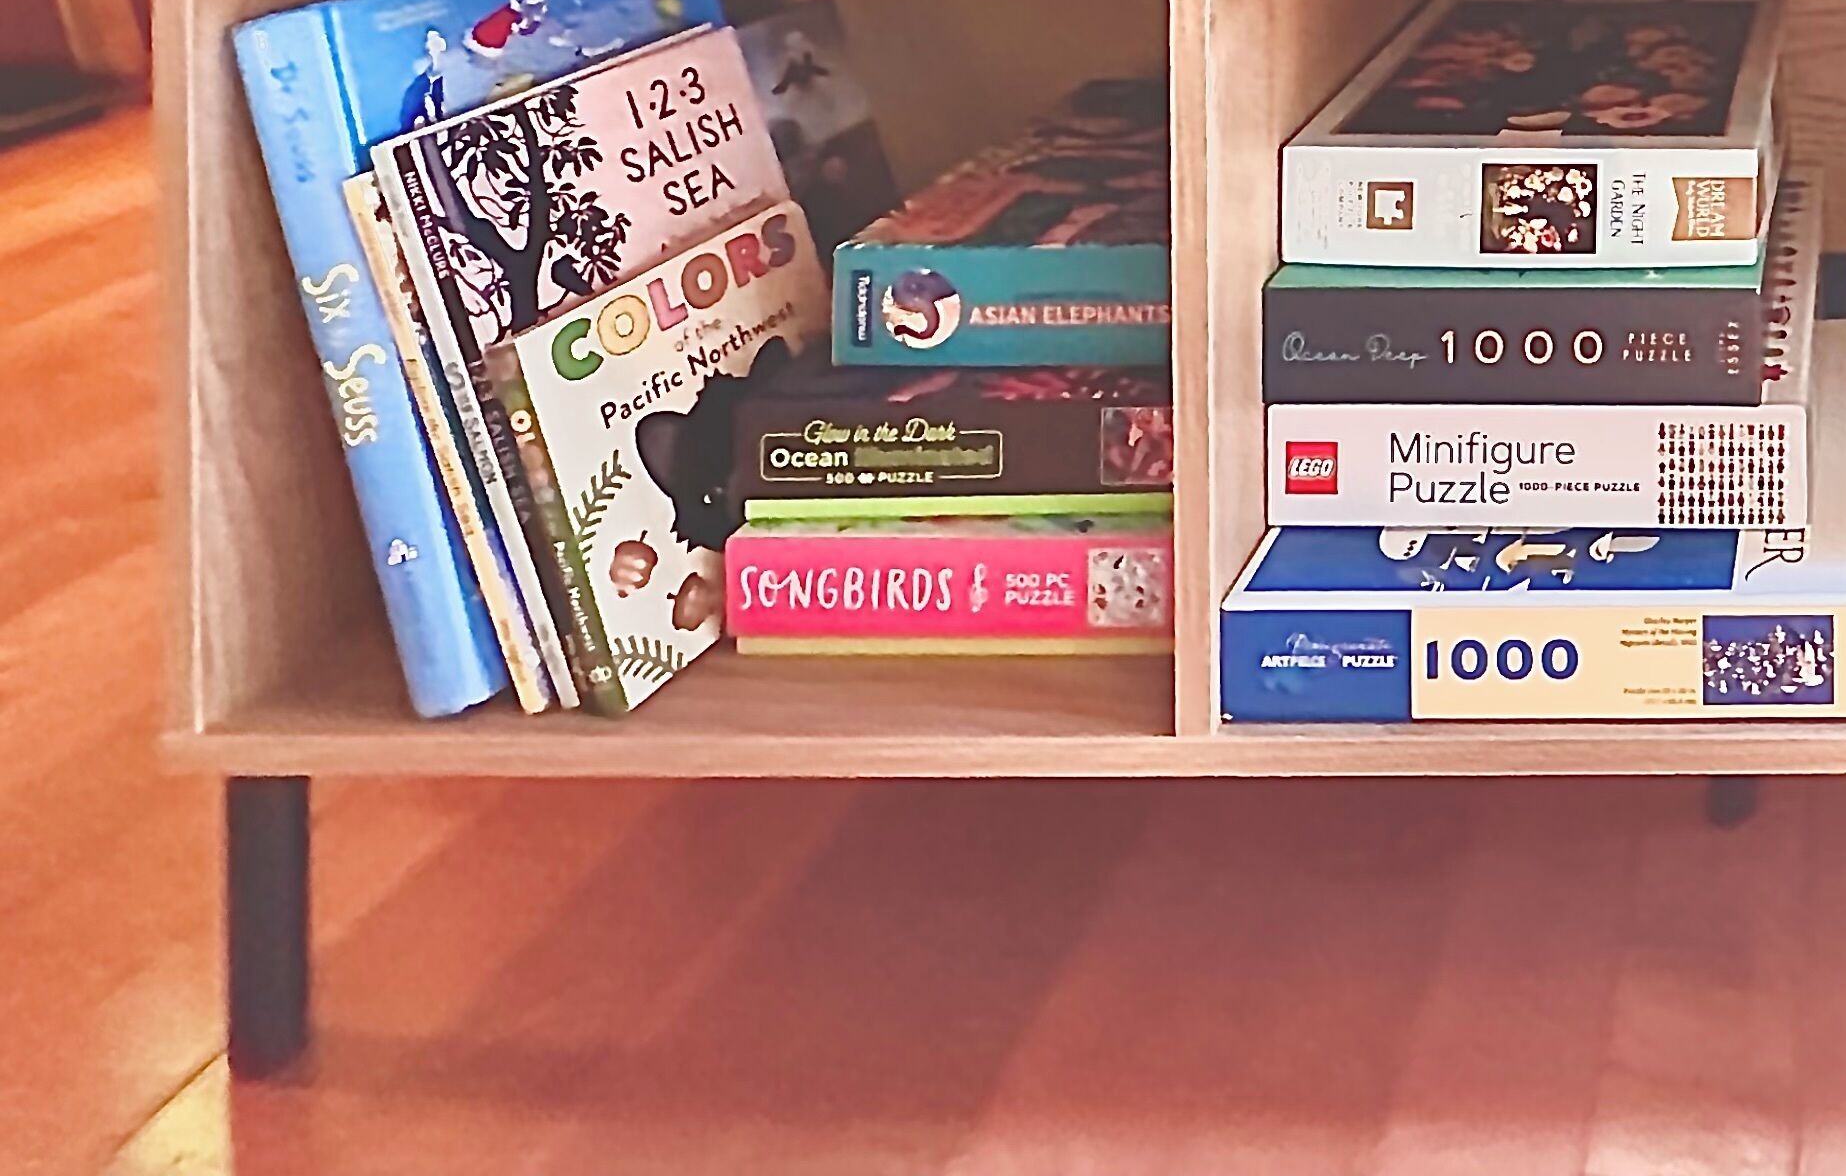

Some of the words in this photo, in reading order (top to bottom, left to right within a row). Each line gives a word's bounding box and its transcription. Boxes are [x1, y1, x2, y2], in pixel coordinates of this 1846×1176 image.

[620, 103, 743, 183] SALISH
[663, 164, 736, 216] SEA
[1631, 173, 1646, 196] THE
[404, 171, 427, 212] NIKKI
[420, 213, 450, 281] McCLURE
[1609, 179, 1626, 239] GARDEN
[1631, 203, 1646, 245] NIGHT
[1696, 179, 1710, 238] WORLD
[1708, 179, 1727, 237] DREAM
[301, 264, 359, 324] Six
[551, 213, 796, 382] COLORS
[969, 306, 1037, 325] ASIAN
[1042, 304, 1171, 324] ELEPHANTS
[674, 333, 693, 353] of
[695, 316, 722, 340] the
[1281, 331, 1361, 363] Ocean
[1627, 332, 1688, 345] PIECE
[600, 370, 684, 429] Pacific
[687, 302, 796, 376] Northwest
[1622, 349, 1692, 362] PUZZLE
[323, 343, 386, 448] Seuss
[803, 420, 849, 444] Glow
[853, 423, 870, 443] in
[873, 421, 899, 443] the
[901, 417, 956, 443] Dark
[771, 448, 849, 469] Ocean
[1287, 455, 1336, 479] LEGO
[1389, 432, 1576, 475] Minifigure
[878, 471, 935, 484] PUZZLE
[1389, 471, 1511, 505] Puzzle
[1593, 482, 1640, 492] PUZZLE
[739, 565, 954, 613] SONGBIRDS
[1004, 573, 1040, 587] 500
[1045, 573, 1070, 587] PC
[1004, 591, 1075, 606] PUZZLE
[566, 586, 601, 652] Northwest
[1342, 654, 1398, 668] PUZZLE
[1426, 638, 1580, 681] 1000
